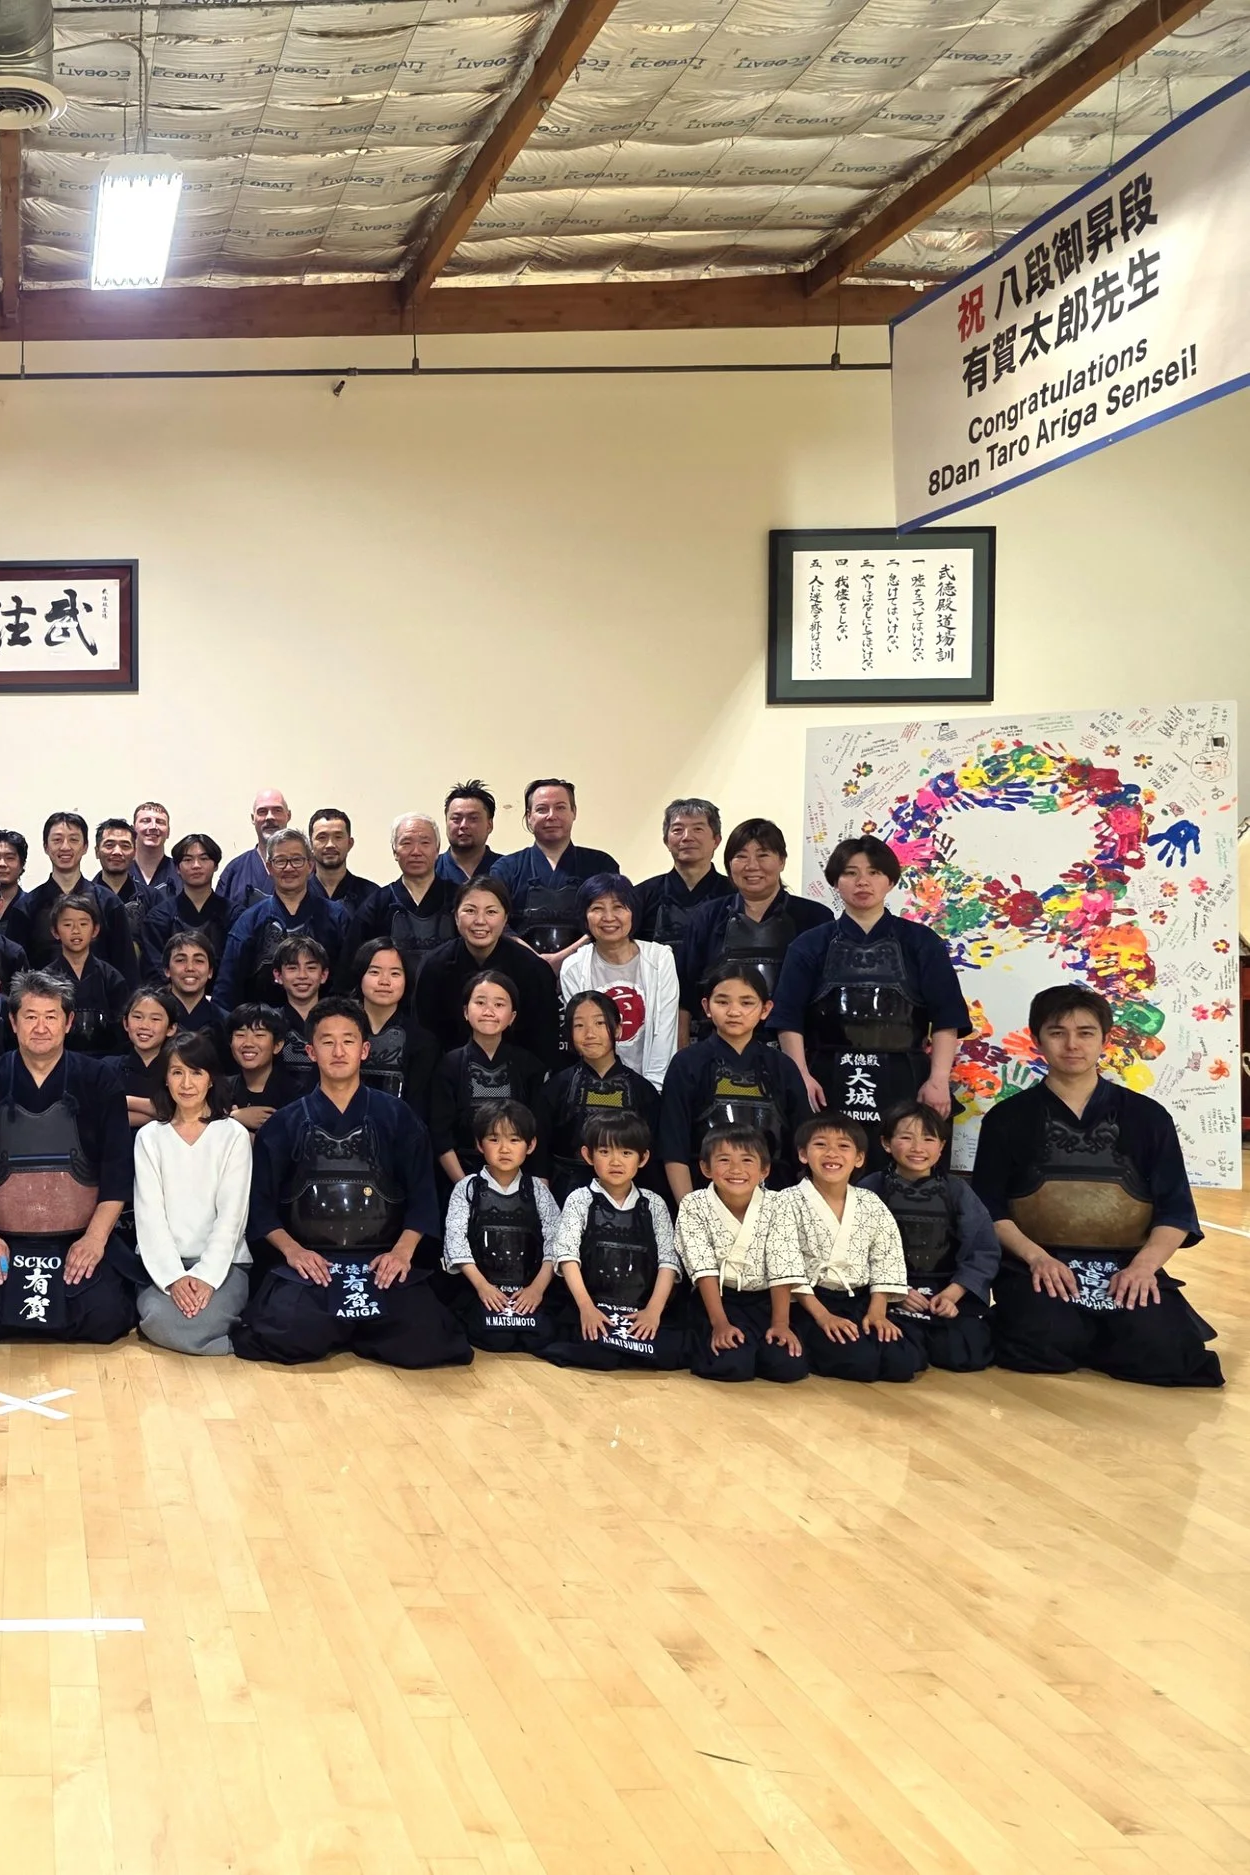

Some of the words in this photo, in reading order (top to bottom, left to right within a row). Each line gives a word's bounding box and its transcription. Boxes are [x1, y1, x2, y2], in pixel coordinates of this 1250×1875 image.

[630, 56, 705, 69] ECOBATT
[735, 55, 810, 68] ECOBATT
[831, 53, 906, 67] ECOBATT
[57, 68, 131, 78] ECOBATT
[255, 64, 330, 75] ECOBATT
[351, 60, 426, 74] ECOBATT
[152, 70, 226, 81] ECOBATT
[48, 131, 114, 139] ECOBATT
[231, 128, 298, 138] ECOBATT
[958, 284, 985, 343] 祝
[994, 172, 1159, 320] 八段御昇段
[962, 248, 1161, 398] 有賀太郎先生
[968, 338, 1148, 445] Congratulations
[928, 456, 980, 497] 8Dan
[987, 433, 1030, 469] Taro
[1036, 401, 1097, 447] Ariga
[1106, 344, 1198, 414] Sensei!
[845, 1067, 877, 1108] 大城
[841, 1110, 881, 1122] ARUKA
[13, 1255, 62, 1269] SCKO
[19, 1268, 53, 1323] 有賀
[343, 1275, 369, 1309] 有賀
[336, 1307, 381, 1318] ARIGA
[485, 1316, 536, 1327] N.MATSUMOTO
